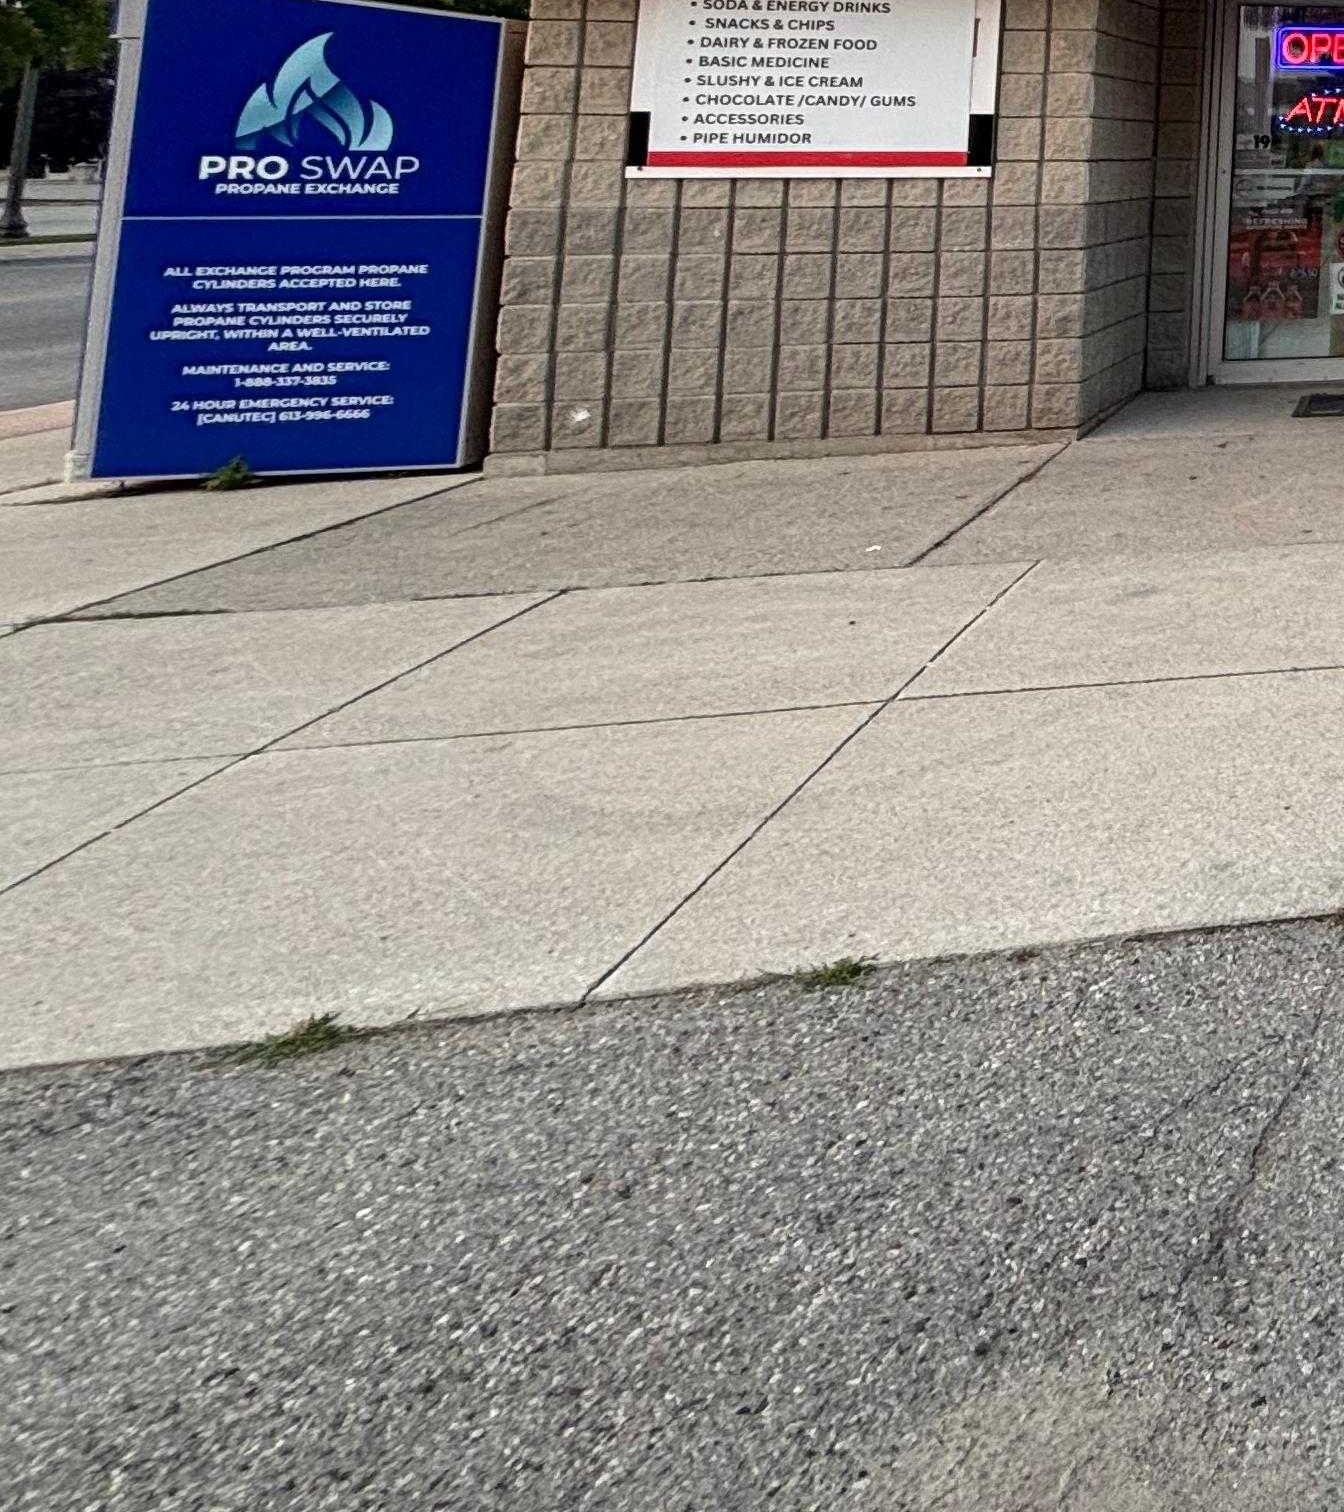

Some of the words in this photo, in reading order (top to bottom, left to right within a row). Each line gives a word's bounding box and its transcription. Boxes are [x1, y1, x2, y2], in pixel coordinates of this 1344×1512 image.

[703, 0, 749, 11] SODA
[752, 0, 763, 11] &
[766, 0, 830, 12] ENERGY
[832, 1, 891, 13] DRINKS
[705, 18, 770, 30] SNACKS
[772, 19, 783, 30] &
[787, 19, 836, 31] CHIPS
[700, 37, 750, 49] DAIRY
[752, 38, 764, 49] &
[768, 38, 829, 50] FROZEN
[833, 39, 878, 50] FOOD
[698, 56, 748, 68] BASIC
[751, 56, 830, 68] MEDICINE
[696, 75, 761, 86] SLUSHY
[764, 76, 775, 87] &
[779, 76, 805, 87] ICE
[808, 76, 863, 88] CREAM
[695, 94, 795, 106] CHOCOLATE
[797, 94, 867, 108] /CANDY/
[870, 96, 917, 107] GUMS
[693, 113, 805, 125] ACCESSORIES
[693, 133, 729, 144] PIPE
[733, 133, 812, 144] HUMIDOR
[198, 155, 289, 180] PRO
[300, 156, 420, 180] SWAP
[214, 183, 302, 195] PROPANE
[304, 183, 400, 195] EXCHANGE
[163, 267, 192, 277] ALL
[195, 266, 277, 277] EXCHANGE
[280, 265, 355, 275] PROGRAM
[358, 264, 429, 274] PROPANE
[192, 279, 276, 289] CYLINDERS
[278, 278, 356, 288] ACCEPTED
[359, 277, 402, 287] HERE.
[171, 303, 235, 314] ALWAYS
[237, 302, 327, 313] TRANSPORT
[328, 301, 362, 311] AND
[364, 300, 412, 311] STORE
[172, 316, 246, 327] PROPANE
[248, 315, 332, 325] CYLINDERS
[333, 313, 409, 324] SECURELY
[150, 330, 220, 341] UPRIGHT,
[223, 328, 279, 339] WITHIN
[281, 328, 294, 339] A
[296, 326, 431, 338] WELL-VENTILATED
[266, 341, 313, 352] AREA.
[181, 364, 290, 376] MAINTENANCE
[291, 363, 325, 373] AND
[326, 361, 391, 372] SERVICE:
[170, 401, 191, 412] 24
[192, 399, 236, 410] HOUR
[238, 397, 329, 409] EMERGENCY
[330, 395, 395, 407] SERVICE:
